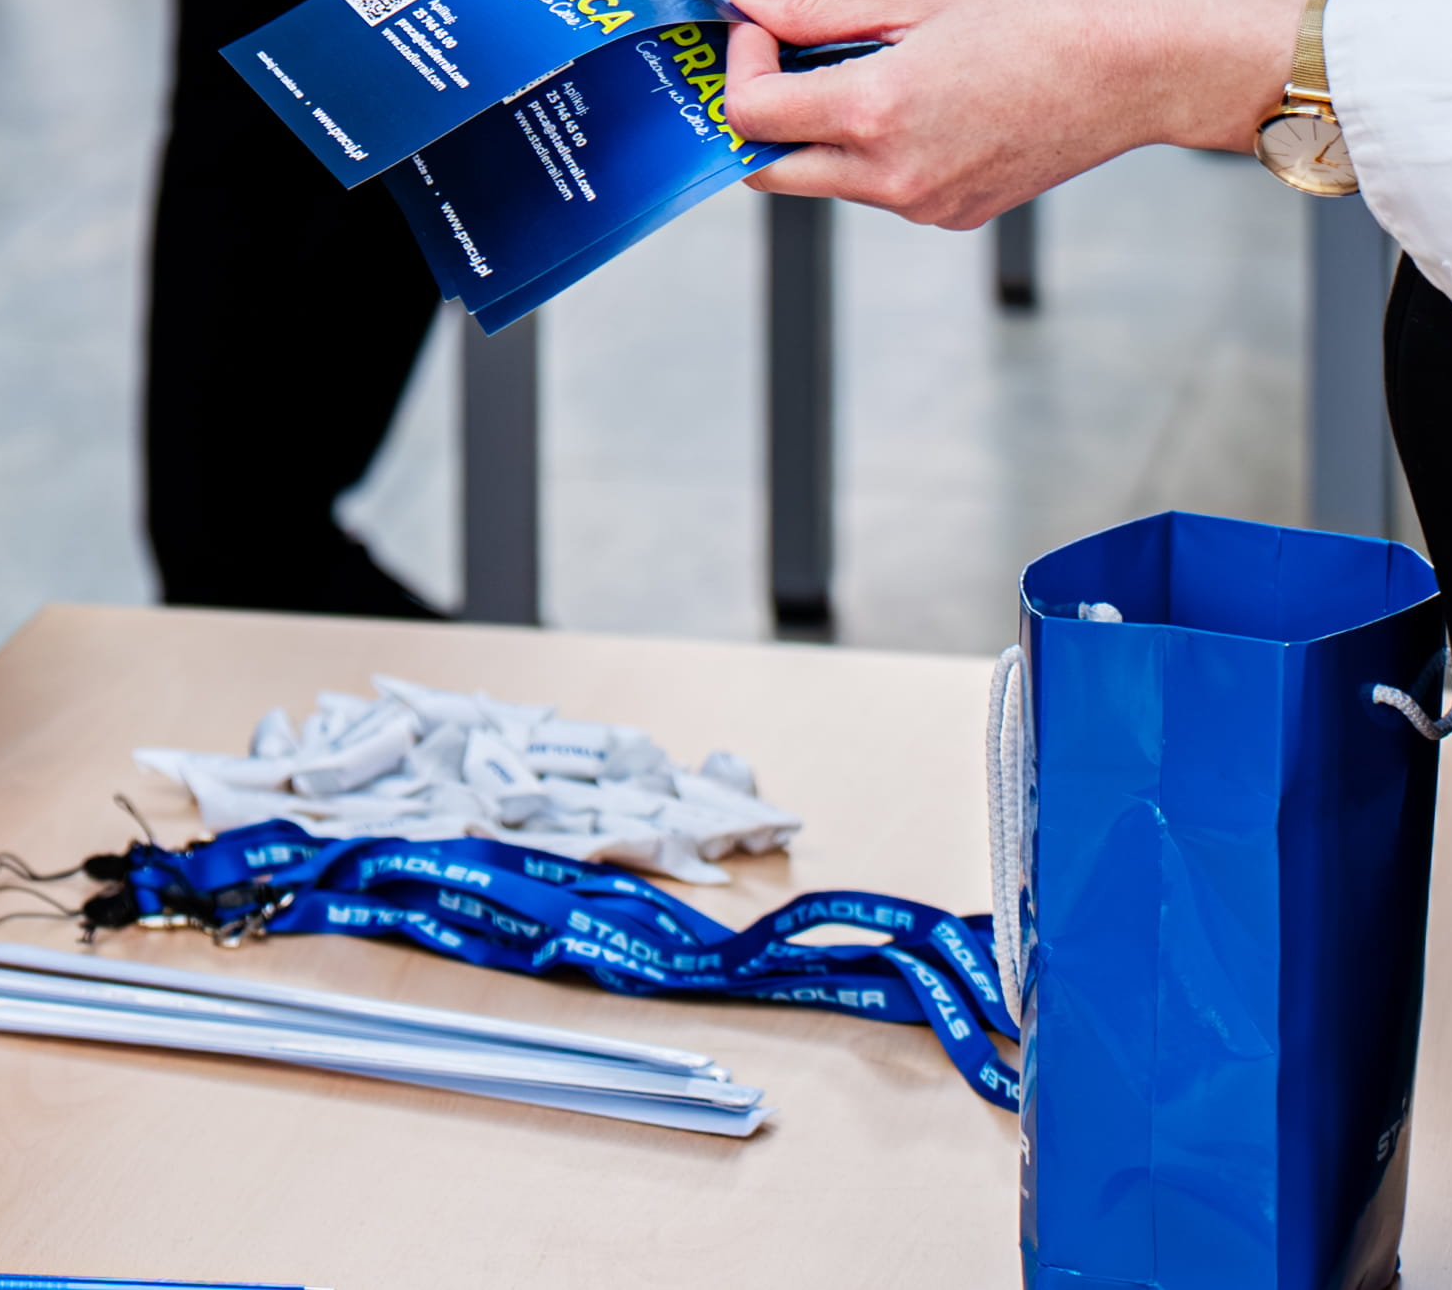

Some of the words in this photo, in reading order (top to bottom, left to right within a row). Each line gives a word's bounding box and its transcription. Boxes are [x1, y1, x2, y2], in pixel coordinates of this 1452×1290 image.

[420, 14, 437, 32] 746
[434, 24, 447, 40] 45
[441, 33, 458, 49] 00
[381, 27, 447, 92] www.stadlerrail.com
[394, 18, 470, 89] praca@stadlerrail.com
[546, 89, 561, 104] 25
[553, 102, 569, 122] 746
[561, 81, 590, 117] Aplikuj:
[668, 89, 685, 105] na
[312, 107, 369, 161] www.pracuj.pl
[564, 117, 580, 134] 45
[571, 132, 588, 148] 00
[513, 109, 574, 202] www.stadlerrail.com
[527, 100, 597, 202] praca@stadlerrail.com
[440, 201, 494, 278] www.pracuj.pl
[360, 854, 492, 889] STADLER
[774, 900, 915, 932] STADLER
[567, 907, 722, 972] STADLER
[932, 922, 999, 1003] STADLER
